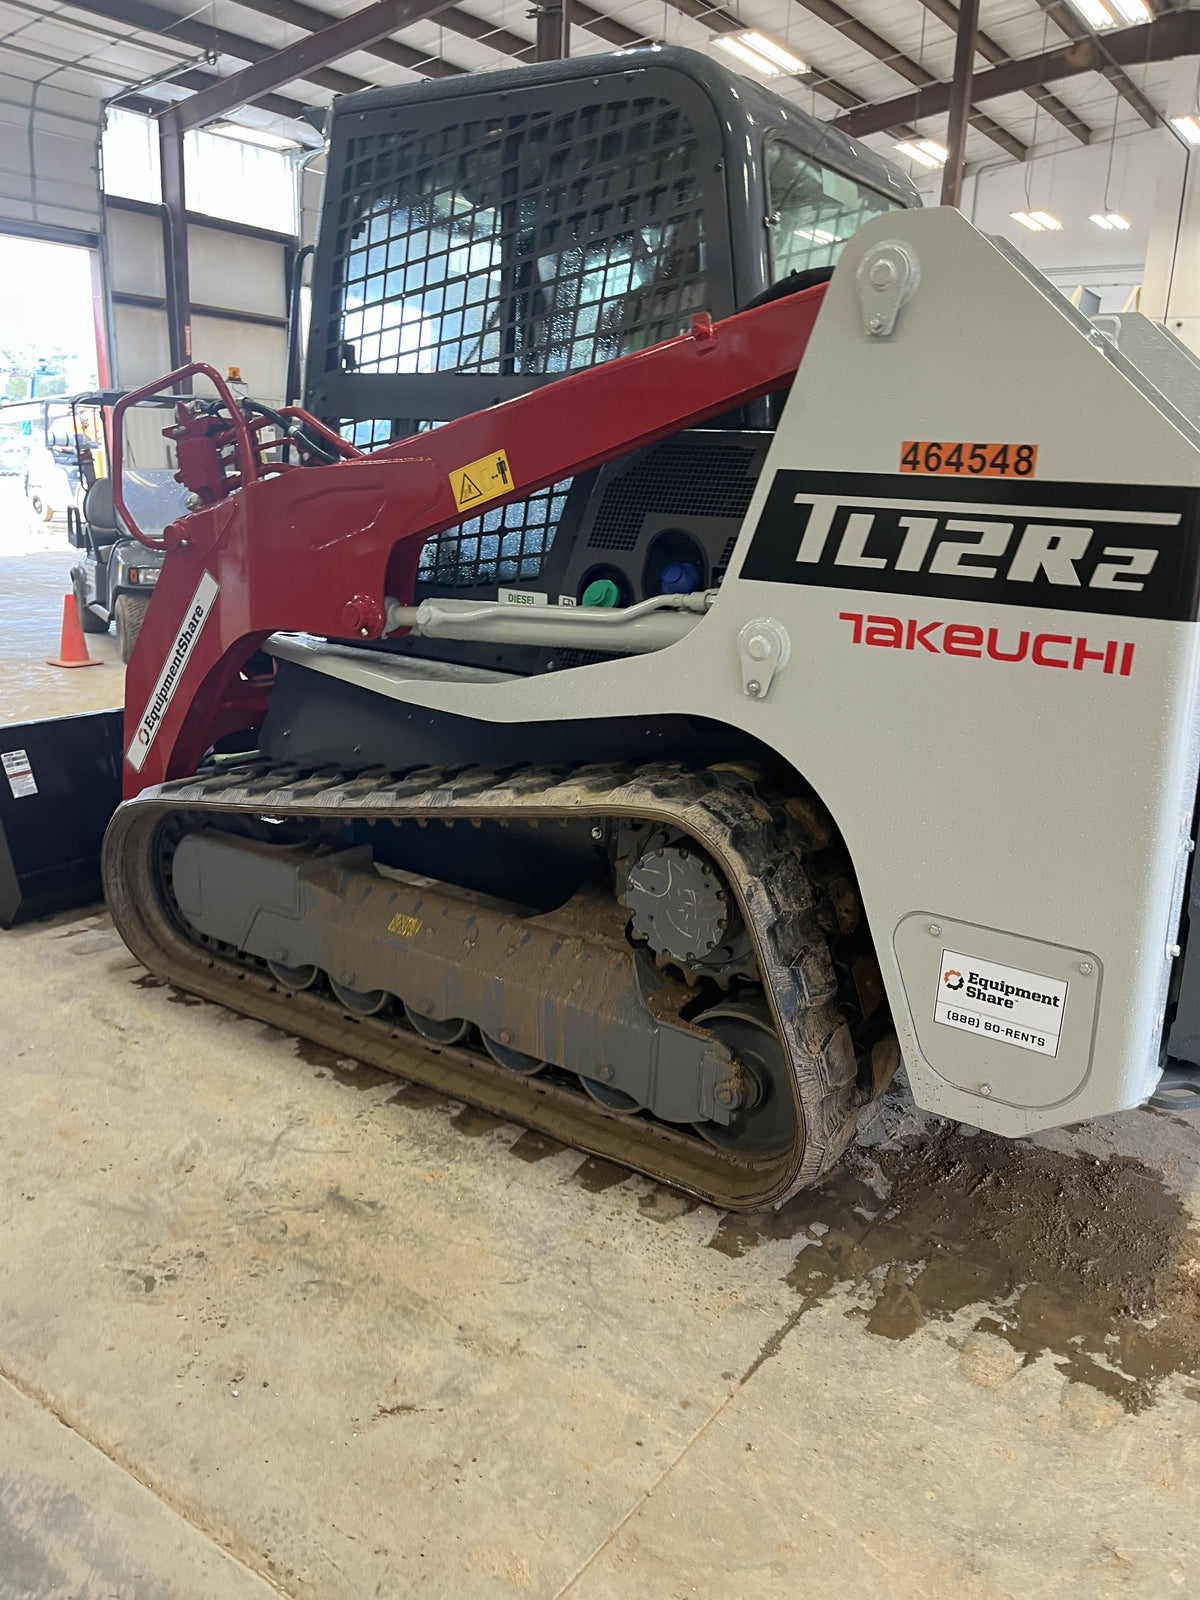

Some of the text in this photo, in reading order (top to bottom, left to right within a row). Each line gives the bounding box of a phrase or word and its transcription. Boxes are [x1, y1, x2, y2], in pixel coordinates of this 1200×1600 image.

[902, 442, 1034, 475] 464548
[794, 493, 1182, 591] TL12R2
[144, 604, 204, 730] EquipmentShare
[967, 971, 1060, 1008] Equipment
[946, 1010, 1046, 1047] (888) 80-RENTS
